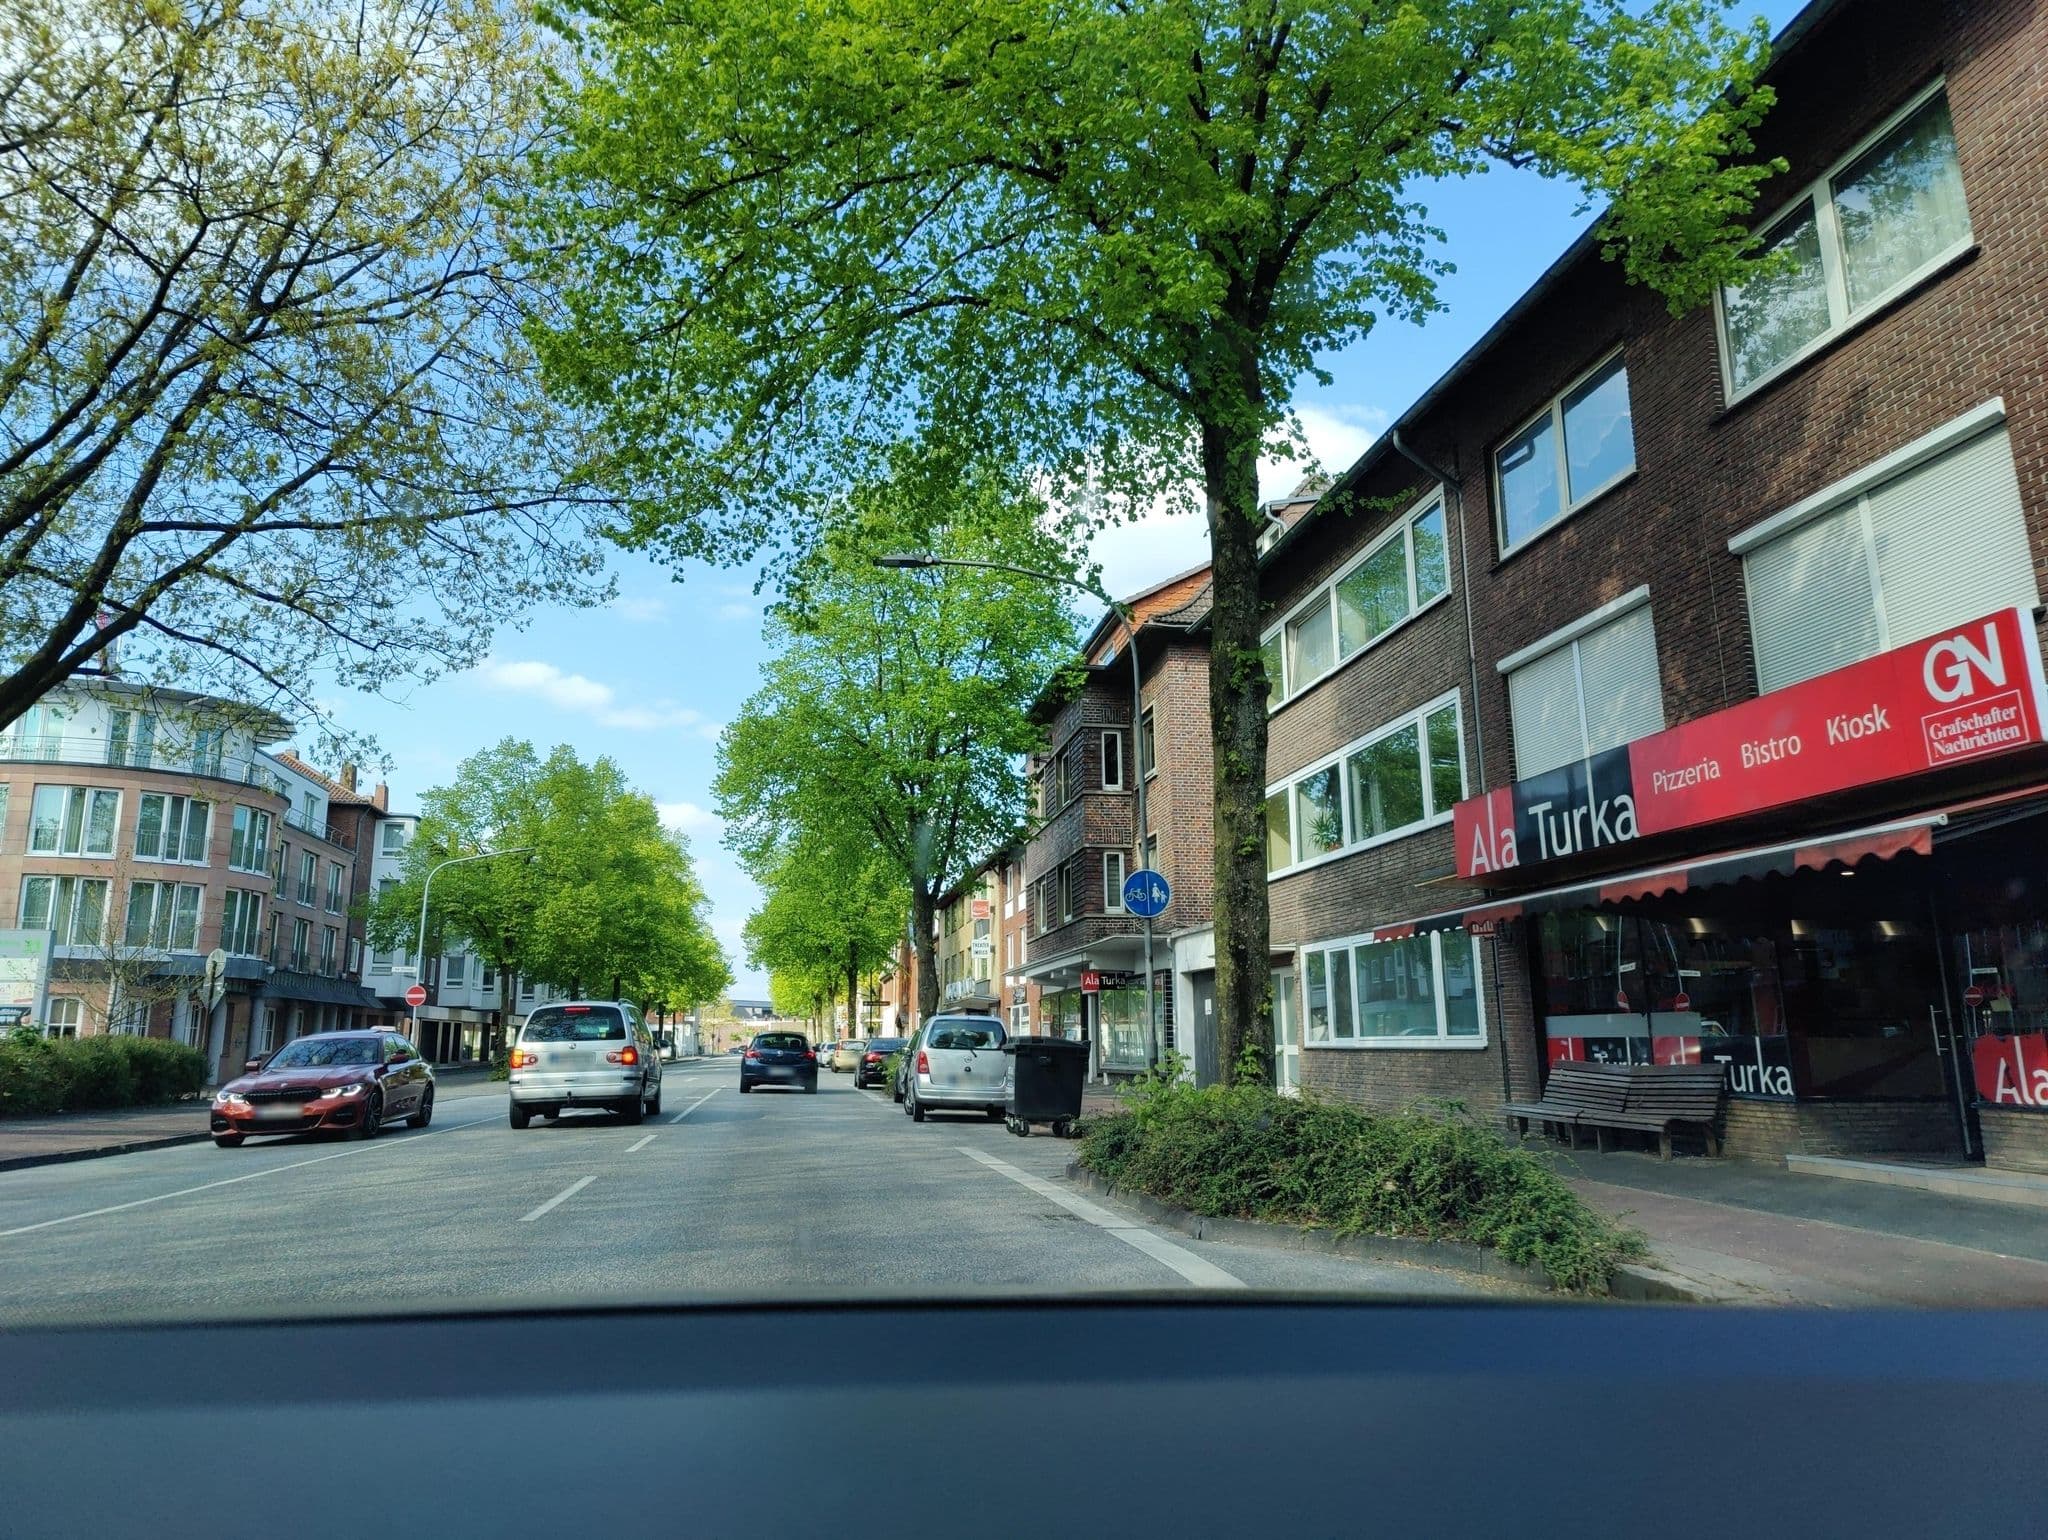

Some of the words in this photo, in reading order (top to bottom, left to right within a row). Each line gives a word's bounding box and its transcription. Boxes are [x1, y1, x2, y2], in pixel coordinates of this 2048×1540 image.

[1923, 621, 2007, 703] GN
[1652, 757, 1721, 795] Pizzeria
[1741, 734, 1802, 769] Bistro
[1826, 703, 1890, 746] Kiosk
[1929, 706, 2017, 740] Grafschafter
[1932, 725, 2021, 758] Nachrichten
[1470, 792, 1520, 877] Ala
[1528, 744, 1640, 860] Turka
[1085, 973, 1099, 985] Ala
[1100, 972, 1126, 985] Turka
[1713, 1036, 1795, 1096] Turka
